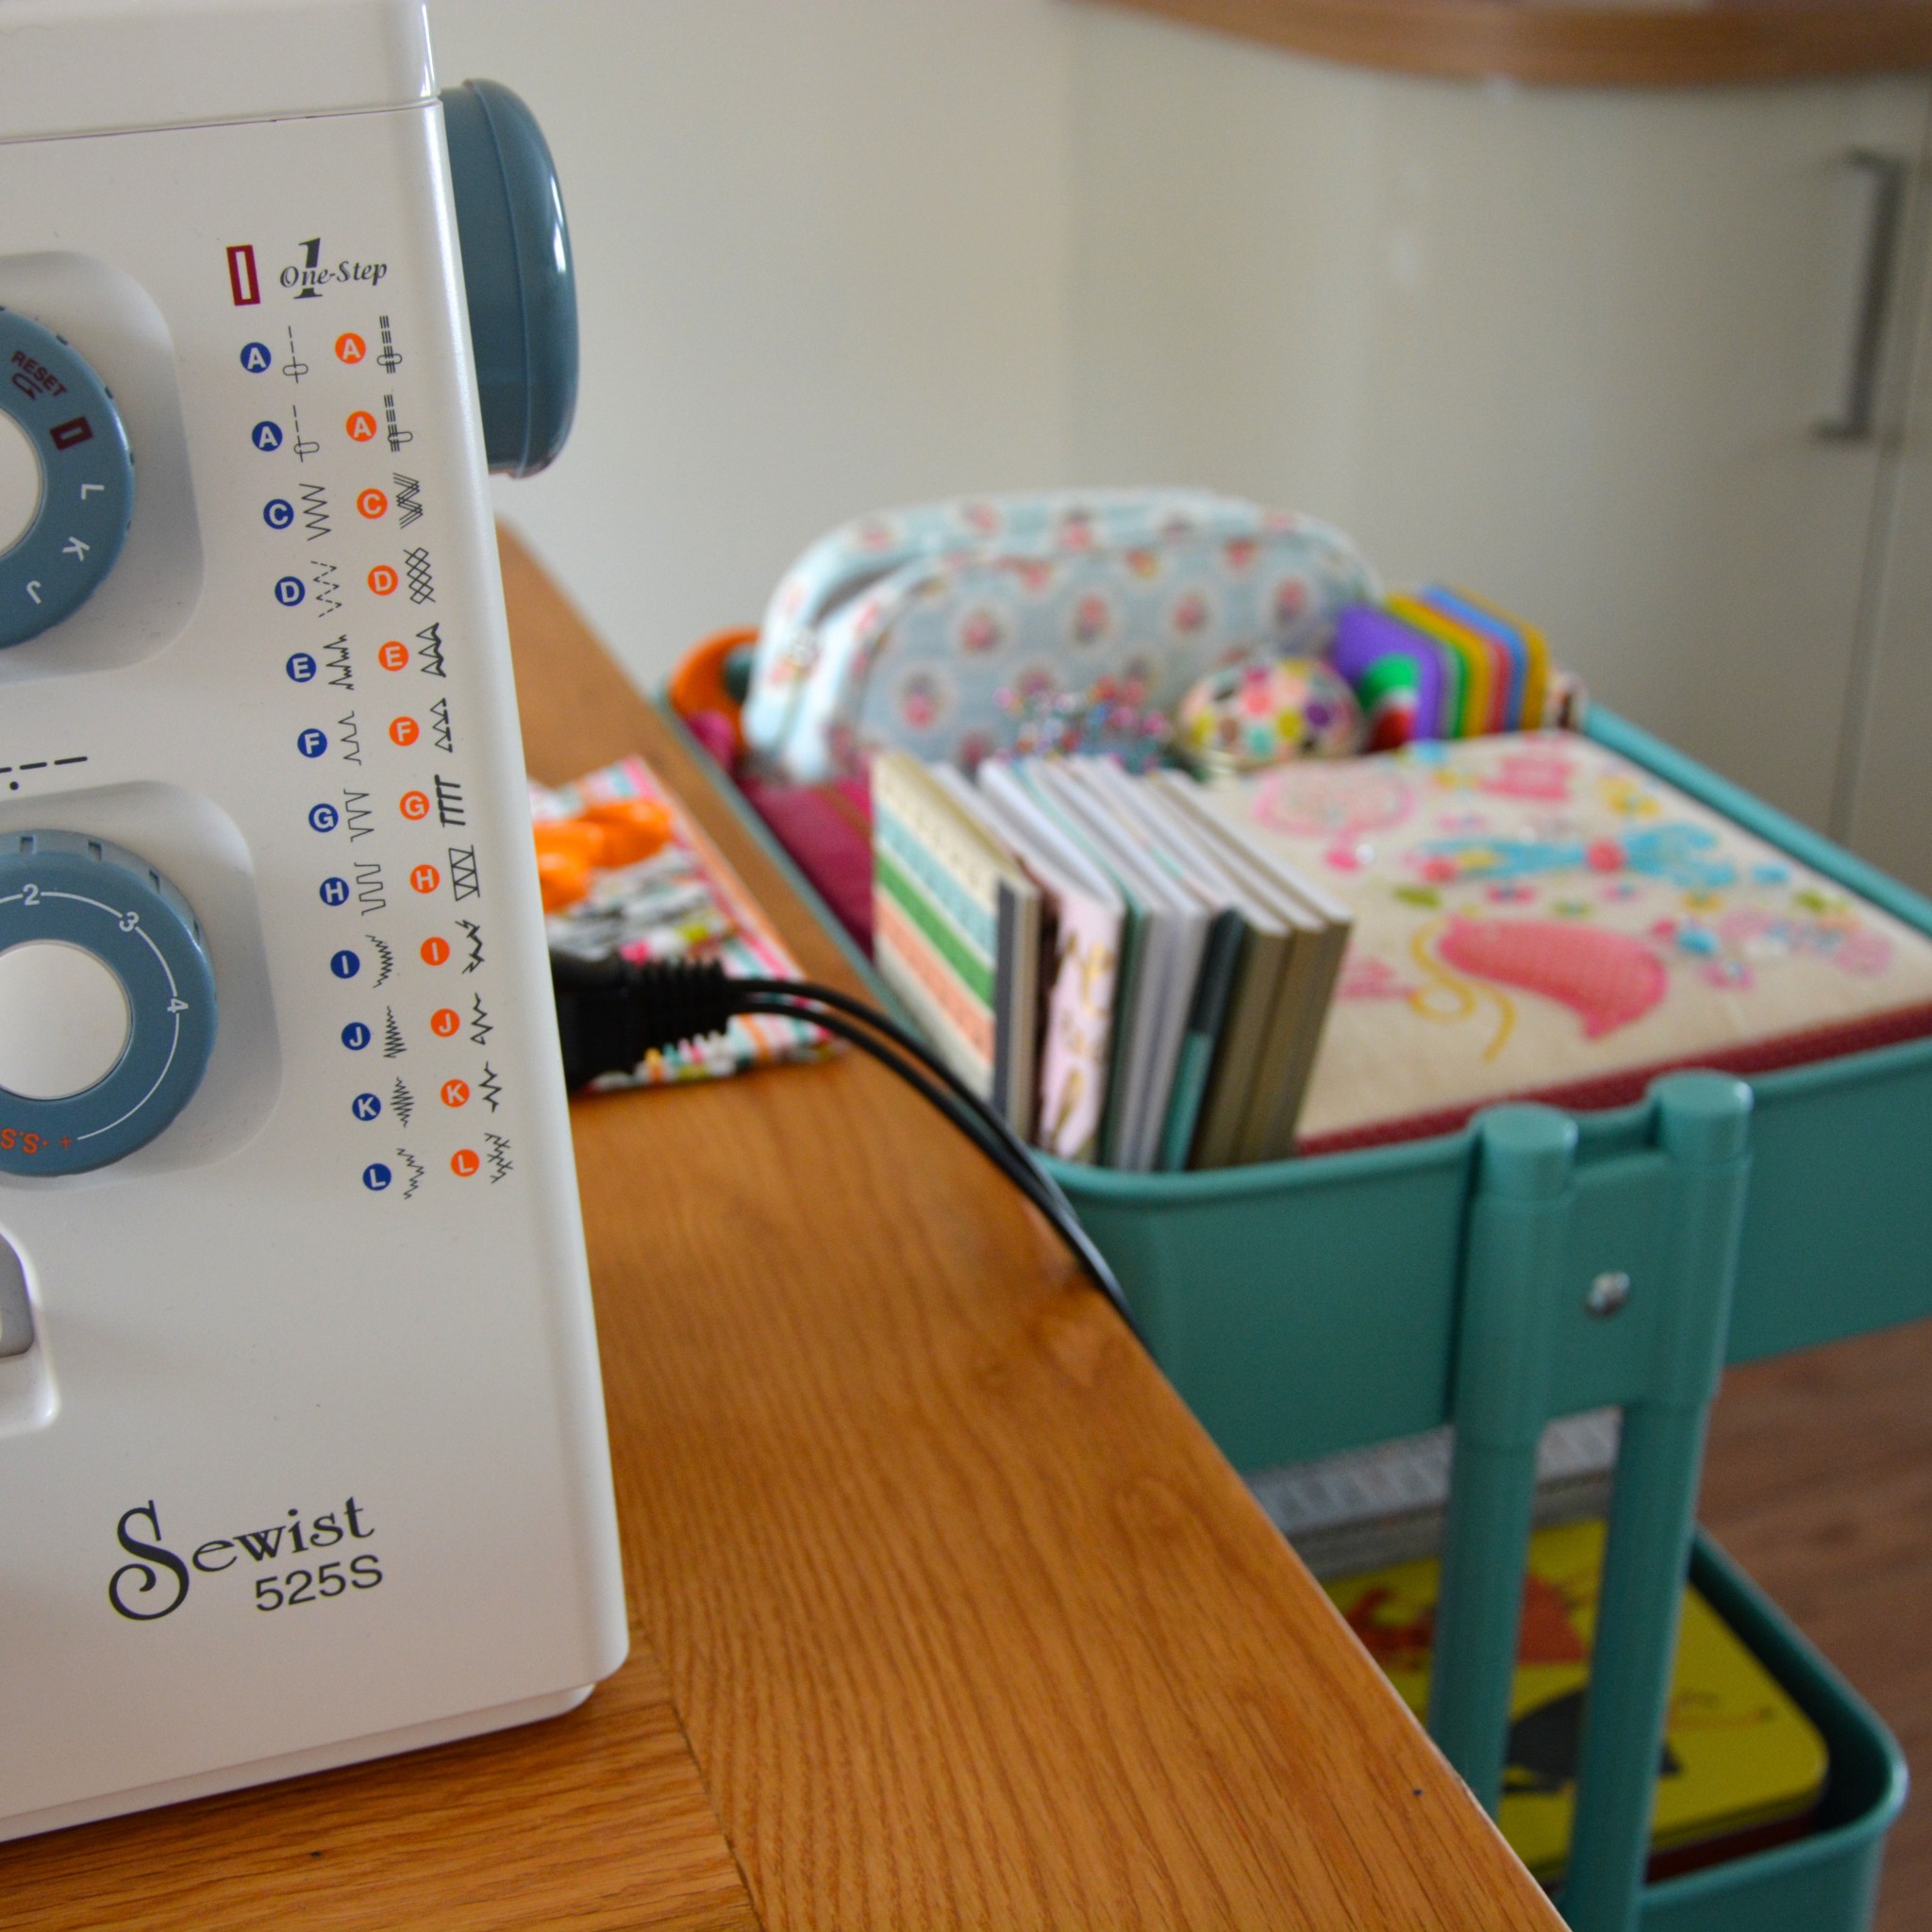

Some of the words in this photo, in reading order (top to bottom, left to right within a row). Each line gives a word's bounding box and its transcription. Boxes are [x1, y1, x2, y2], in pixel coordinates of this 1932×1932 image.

[279, 260, 388, 288] One-Step
[293, 238, 323, 300] 1
[244, 343, 269, 370] A
[341, 336, 361, 360] A
[11, 350, 67, 397] RESET
[257, 424, 278, 449] A
[352, 414, 373, 440] A
[80, 483, 106, 500] L
[361, 491, 382, 516] C
[267, 502, 291, 527] C
[61, 536, 91, 561] K
[25, 579, 42, 605] J
[279, 579, 301, 603] D
[372, 569, 393, 592] D
[291, 655, 312, 680] E
[384, 644, 404, 668] E
[303, 730, 322, 756] F
[394, 720, 411, 743] F
[403, 793, 425, 818] G
[311, 806, 336, 830] G
[414, 868, 435, 891] H
[22, 883, 41, 906] 2
[323, 880, 344, 904] H
[118, 911, 141, 932] 3
[166, 996, 189, 1013] 4
[437, 1012, 453, 1035] J
[347, 1024, 364, 1049] J
[445, 1082, 466, 1106] K
[356, 1095, 379, 1119] K
[457, 1154, 475, 1174] L
[368, 1167, 388, 1189] L
[108, 1496, 375, 1622] Sewist
[255, 1554, 384, 1612] 525S
